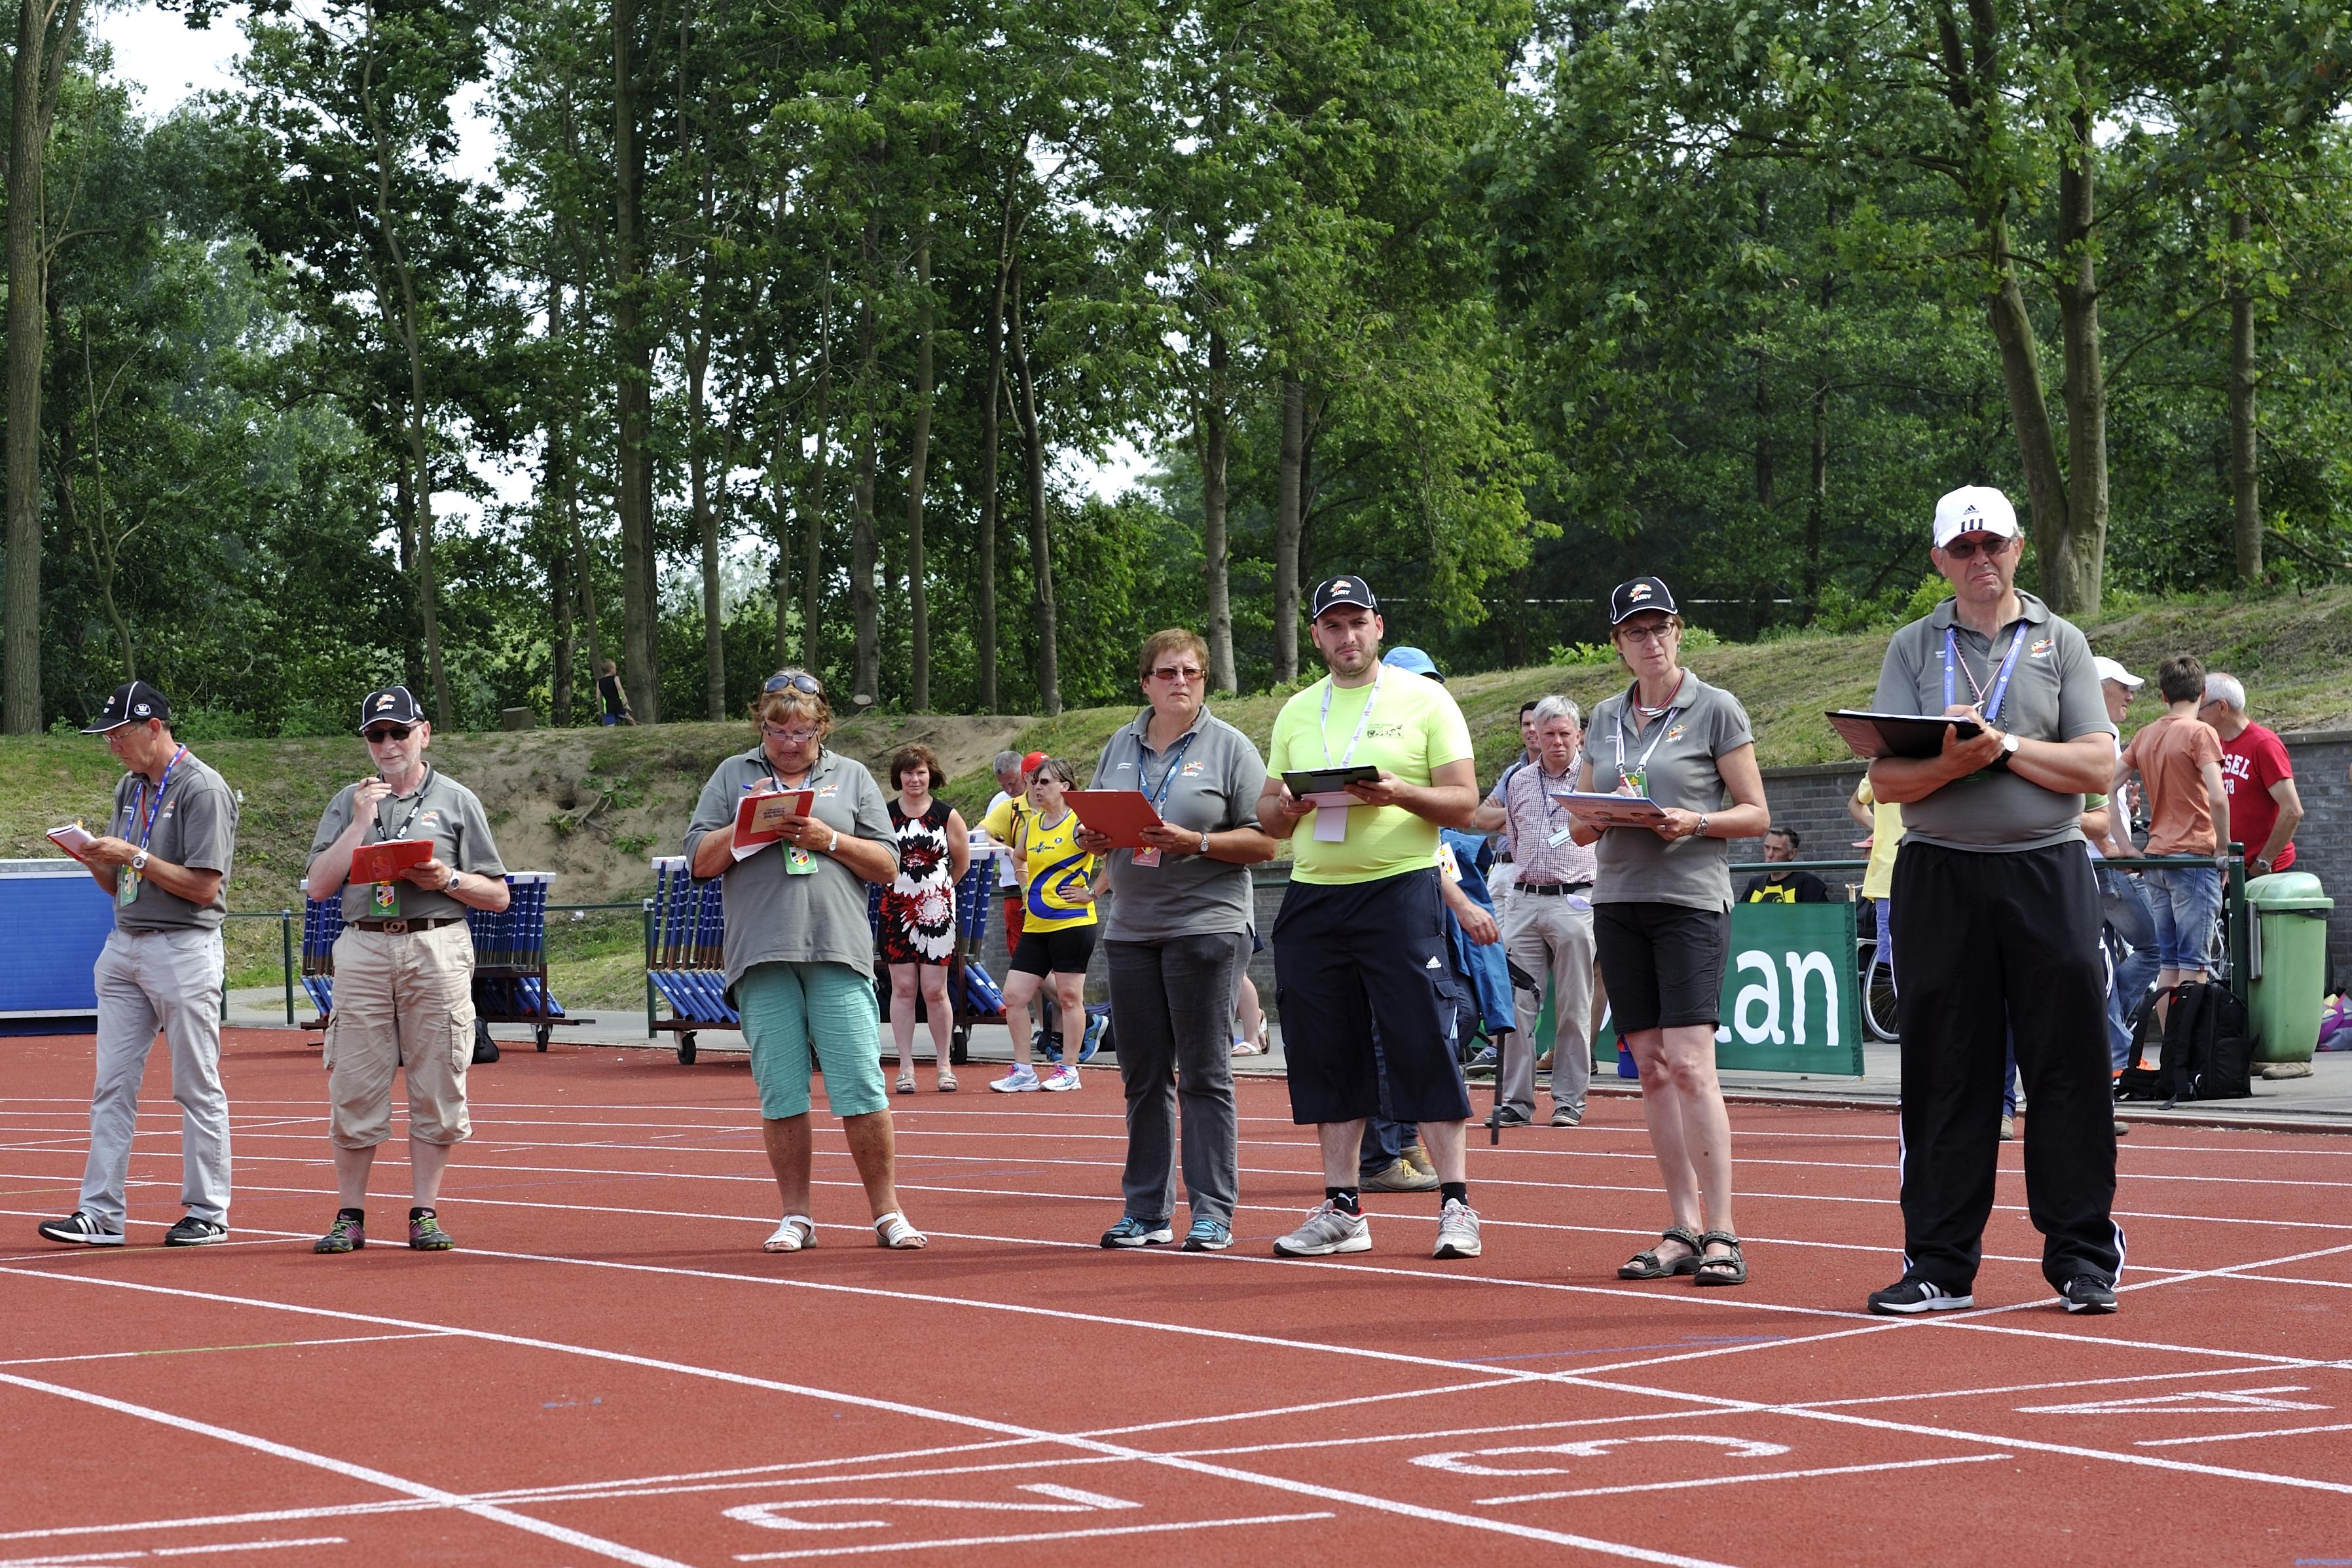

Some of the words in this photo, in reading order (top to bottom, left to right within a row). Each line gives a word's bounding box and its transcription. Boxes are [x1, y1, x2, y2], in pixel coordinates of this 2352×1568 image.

[1331, 589, 1351, 598] JURY
[1632, 594, 1652, 603] JURY
[2030, 649, 2051, 659] JURY
[376, 704, 394, 712] JURY
[1715, 949, 1840, 1046] an
[1407, 1434, 1792, 1476] 3
[720, 1482, 1144, 1531] 2
